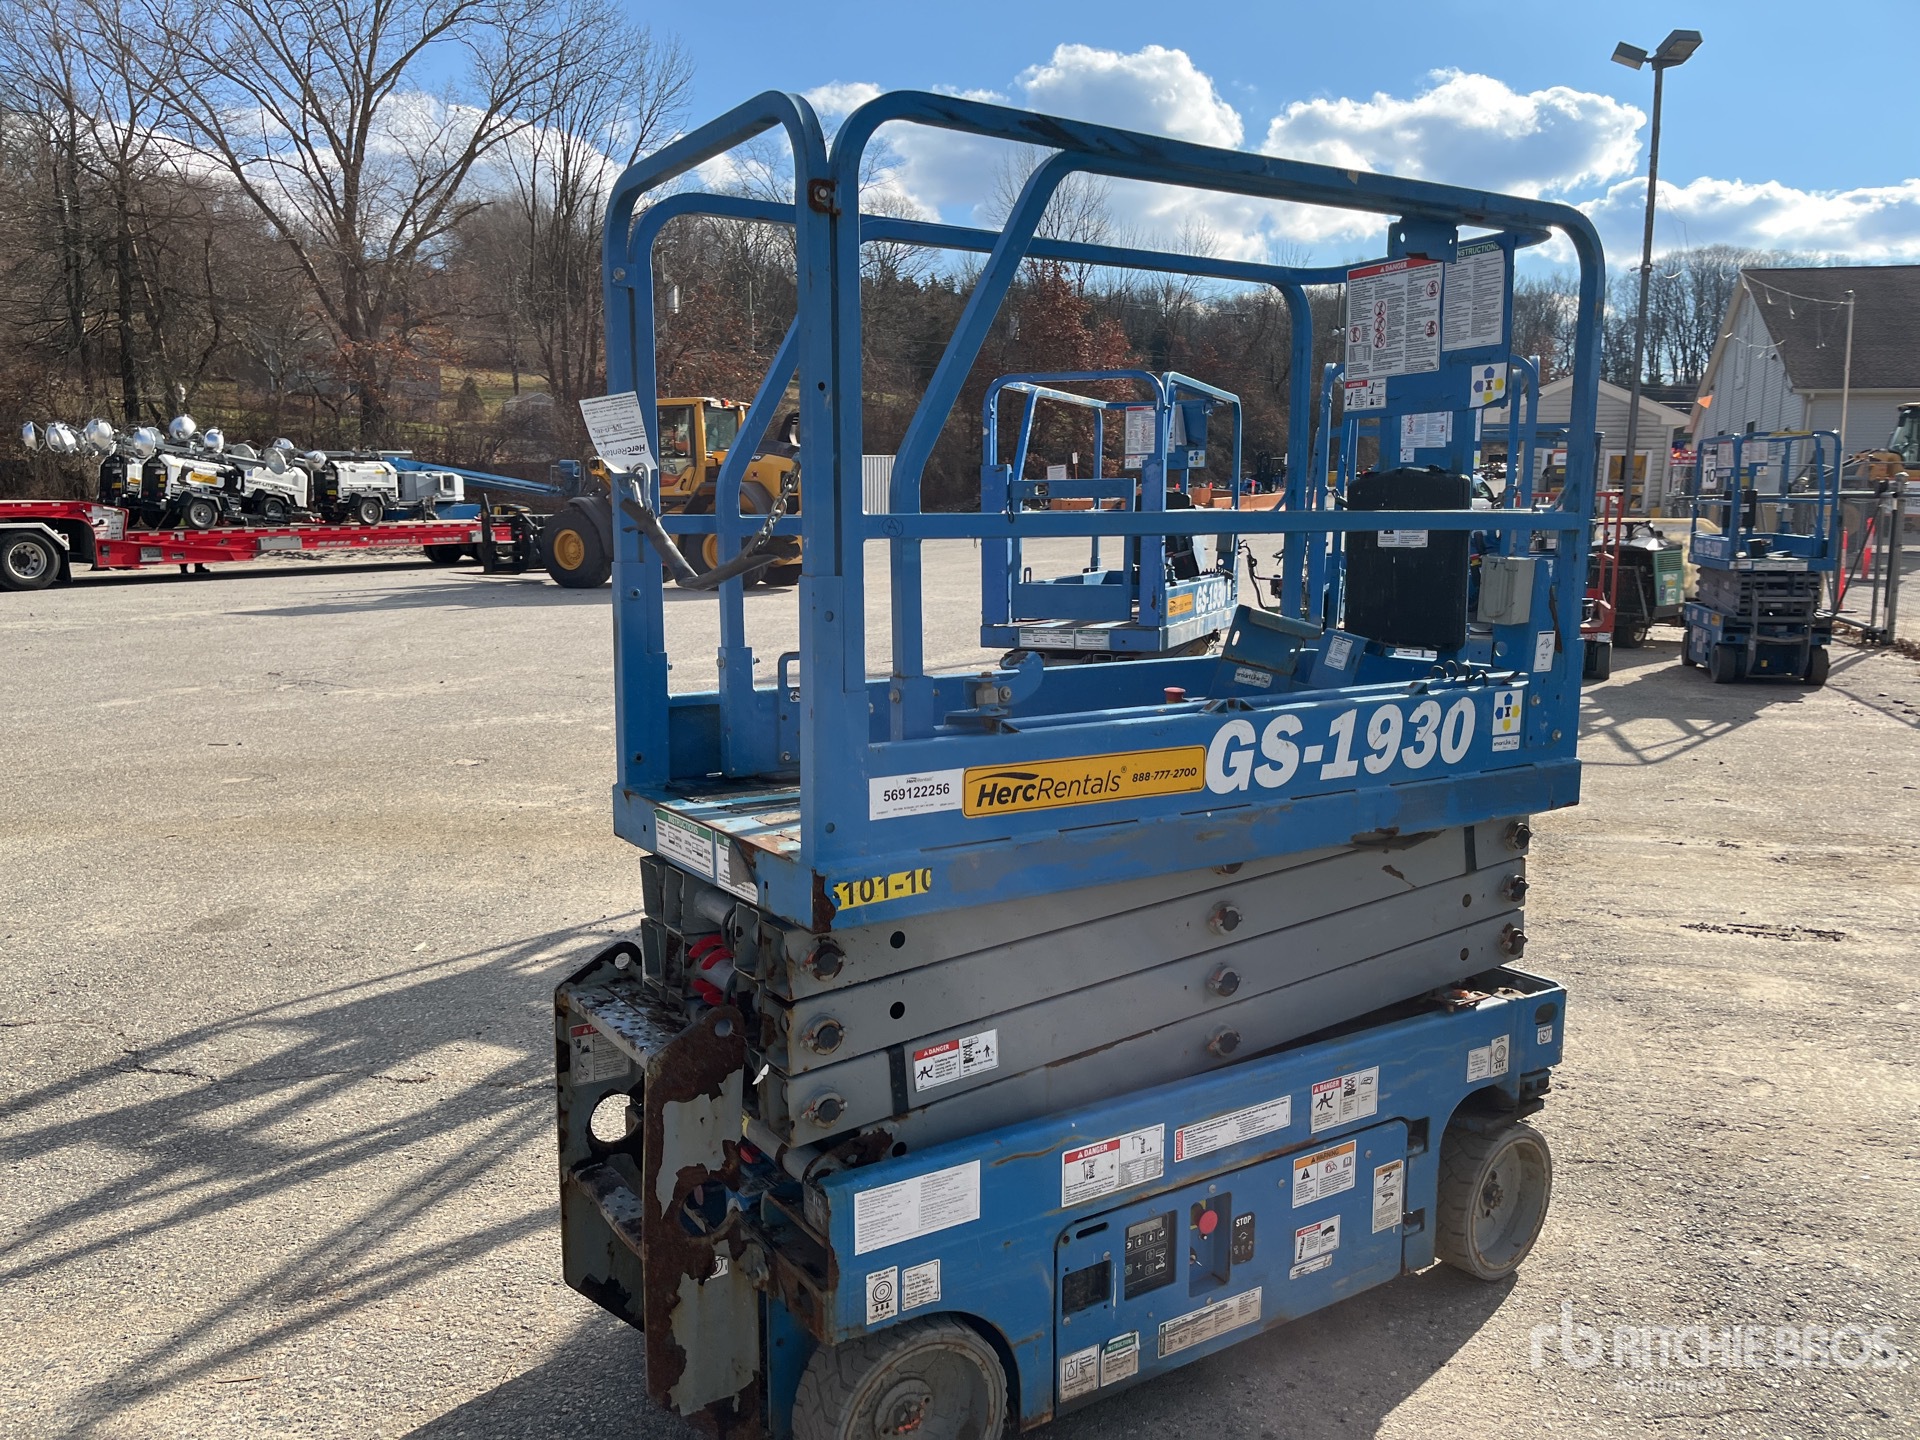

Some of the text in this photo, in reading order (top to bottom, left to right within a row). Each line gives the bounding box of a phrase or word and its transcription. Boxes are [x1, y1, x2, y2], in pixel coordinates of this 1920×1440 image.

[1458, 243, 1499, 257] NSTRUCTIONS
[1385, 262, 1407, 273] DANGER
[602, 444, 646, 458] HercRentals
[1704, 468, 1717, 482] 10
[1205, 697, 1476, 795] GS-1930
[1132, 767, 1197, 783] 888-777-2700
[883, 782, 950, 802] 569122256
[668, 814, 699, 835] INSTRUCTIONS
[928, 1044, 950, 1055] DANGER
[1320, 1080, 1340, 1091] DANGER
[1083, 1144, 1108, 1157] DANGER
[1316, 1149, 1339, 1161] WARNING
[1235, 1215, 1252, 1227] STOP
